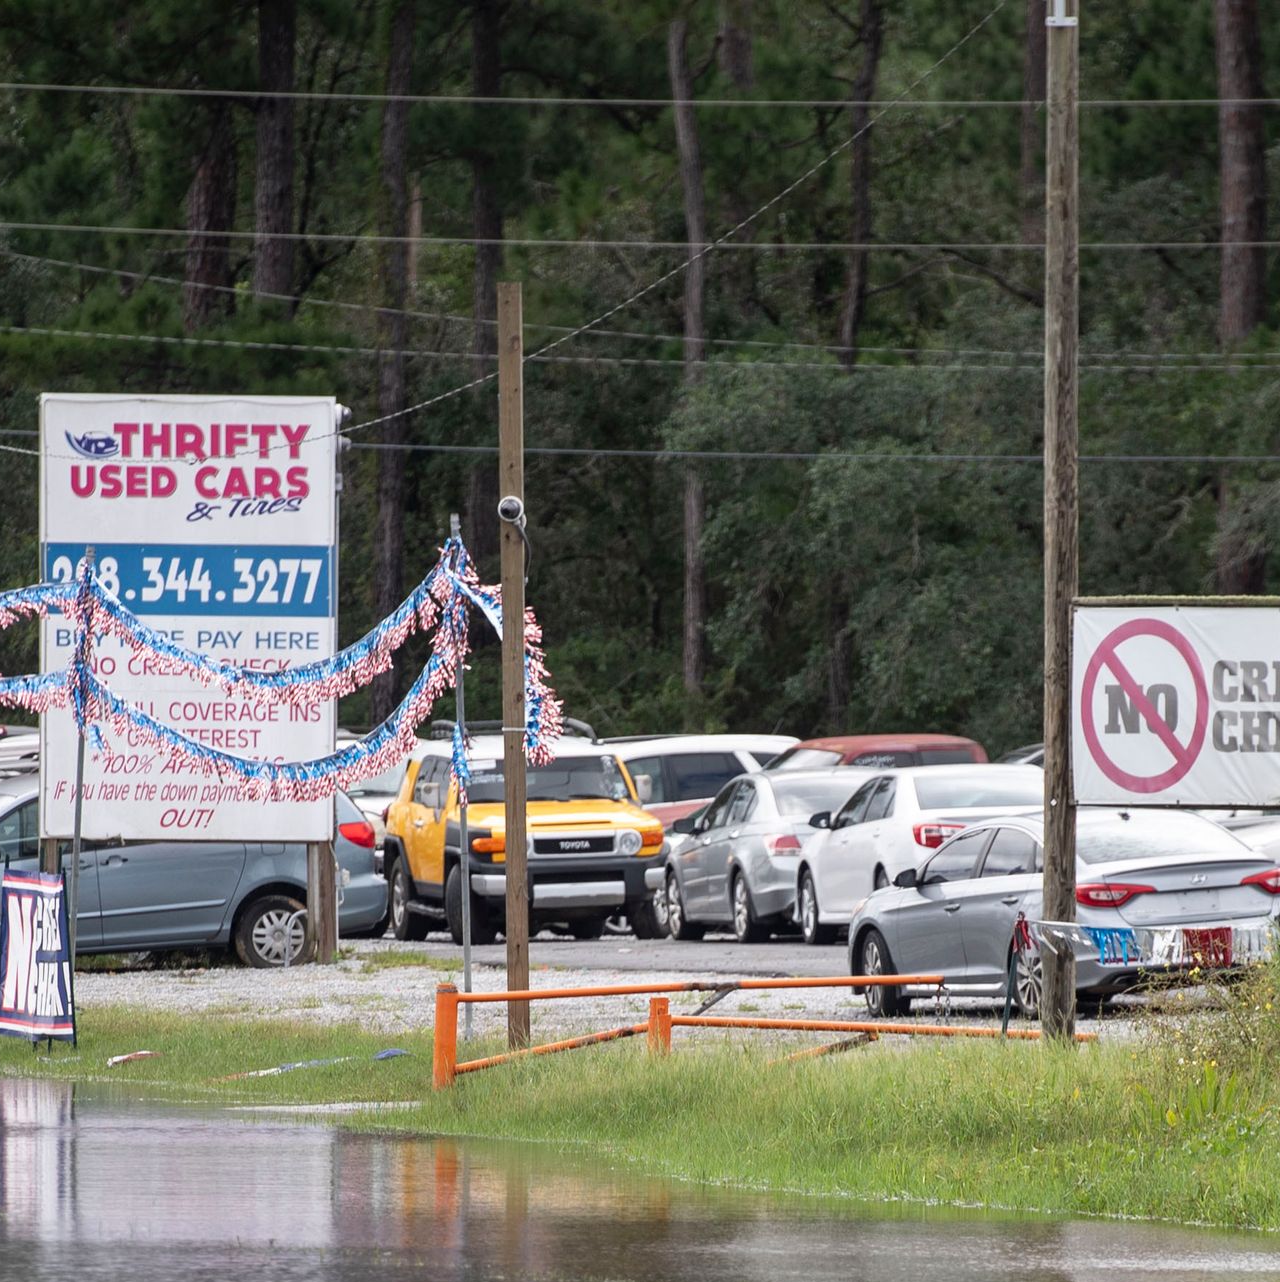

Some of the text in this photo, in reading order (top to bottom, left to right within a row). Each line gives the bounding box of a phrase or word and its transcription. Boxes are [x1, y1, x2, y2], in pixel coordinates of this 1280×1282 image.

[113, 422, 312, 459] THRIFTY
[70, 464, 310, 500] USED CARS
[186, 497, 303, 522] & Tires
[52, 555, 323, 604] 28.344.3277
[56, 629, 106, 647] BY
[197, 631, 242, 650] PAY
[255, 631, 320, 650] HERE
[169, 701, 279, 722] COVERAGE
[289, 702, 322, 722] INS
[1104, 683, 1179, 734] NO
[182, 729, 262, 748] TEREST
[54, 780, 68, 800] IF
[97, 780, 130, 801] have
[134, 780, 157, 801] the
[160, 781, 198, 801] down
[159, 808, 215, 829] OUT!
[559, 840, 591, 850] TOYOTA
